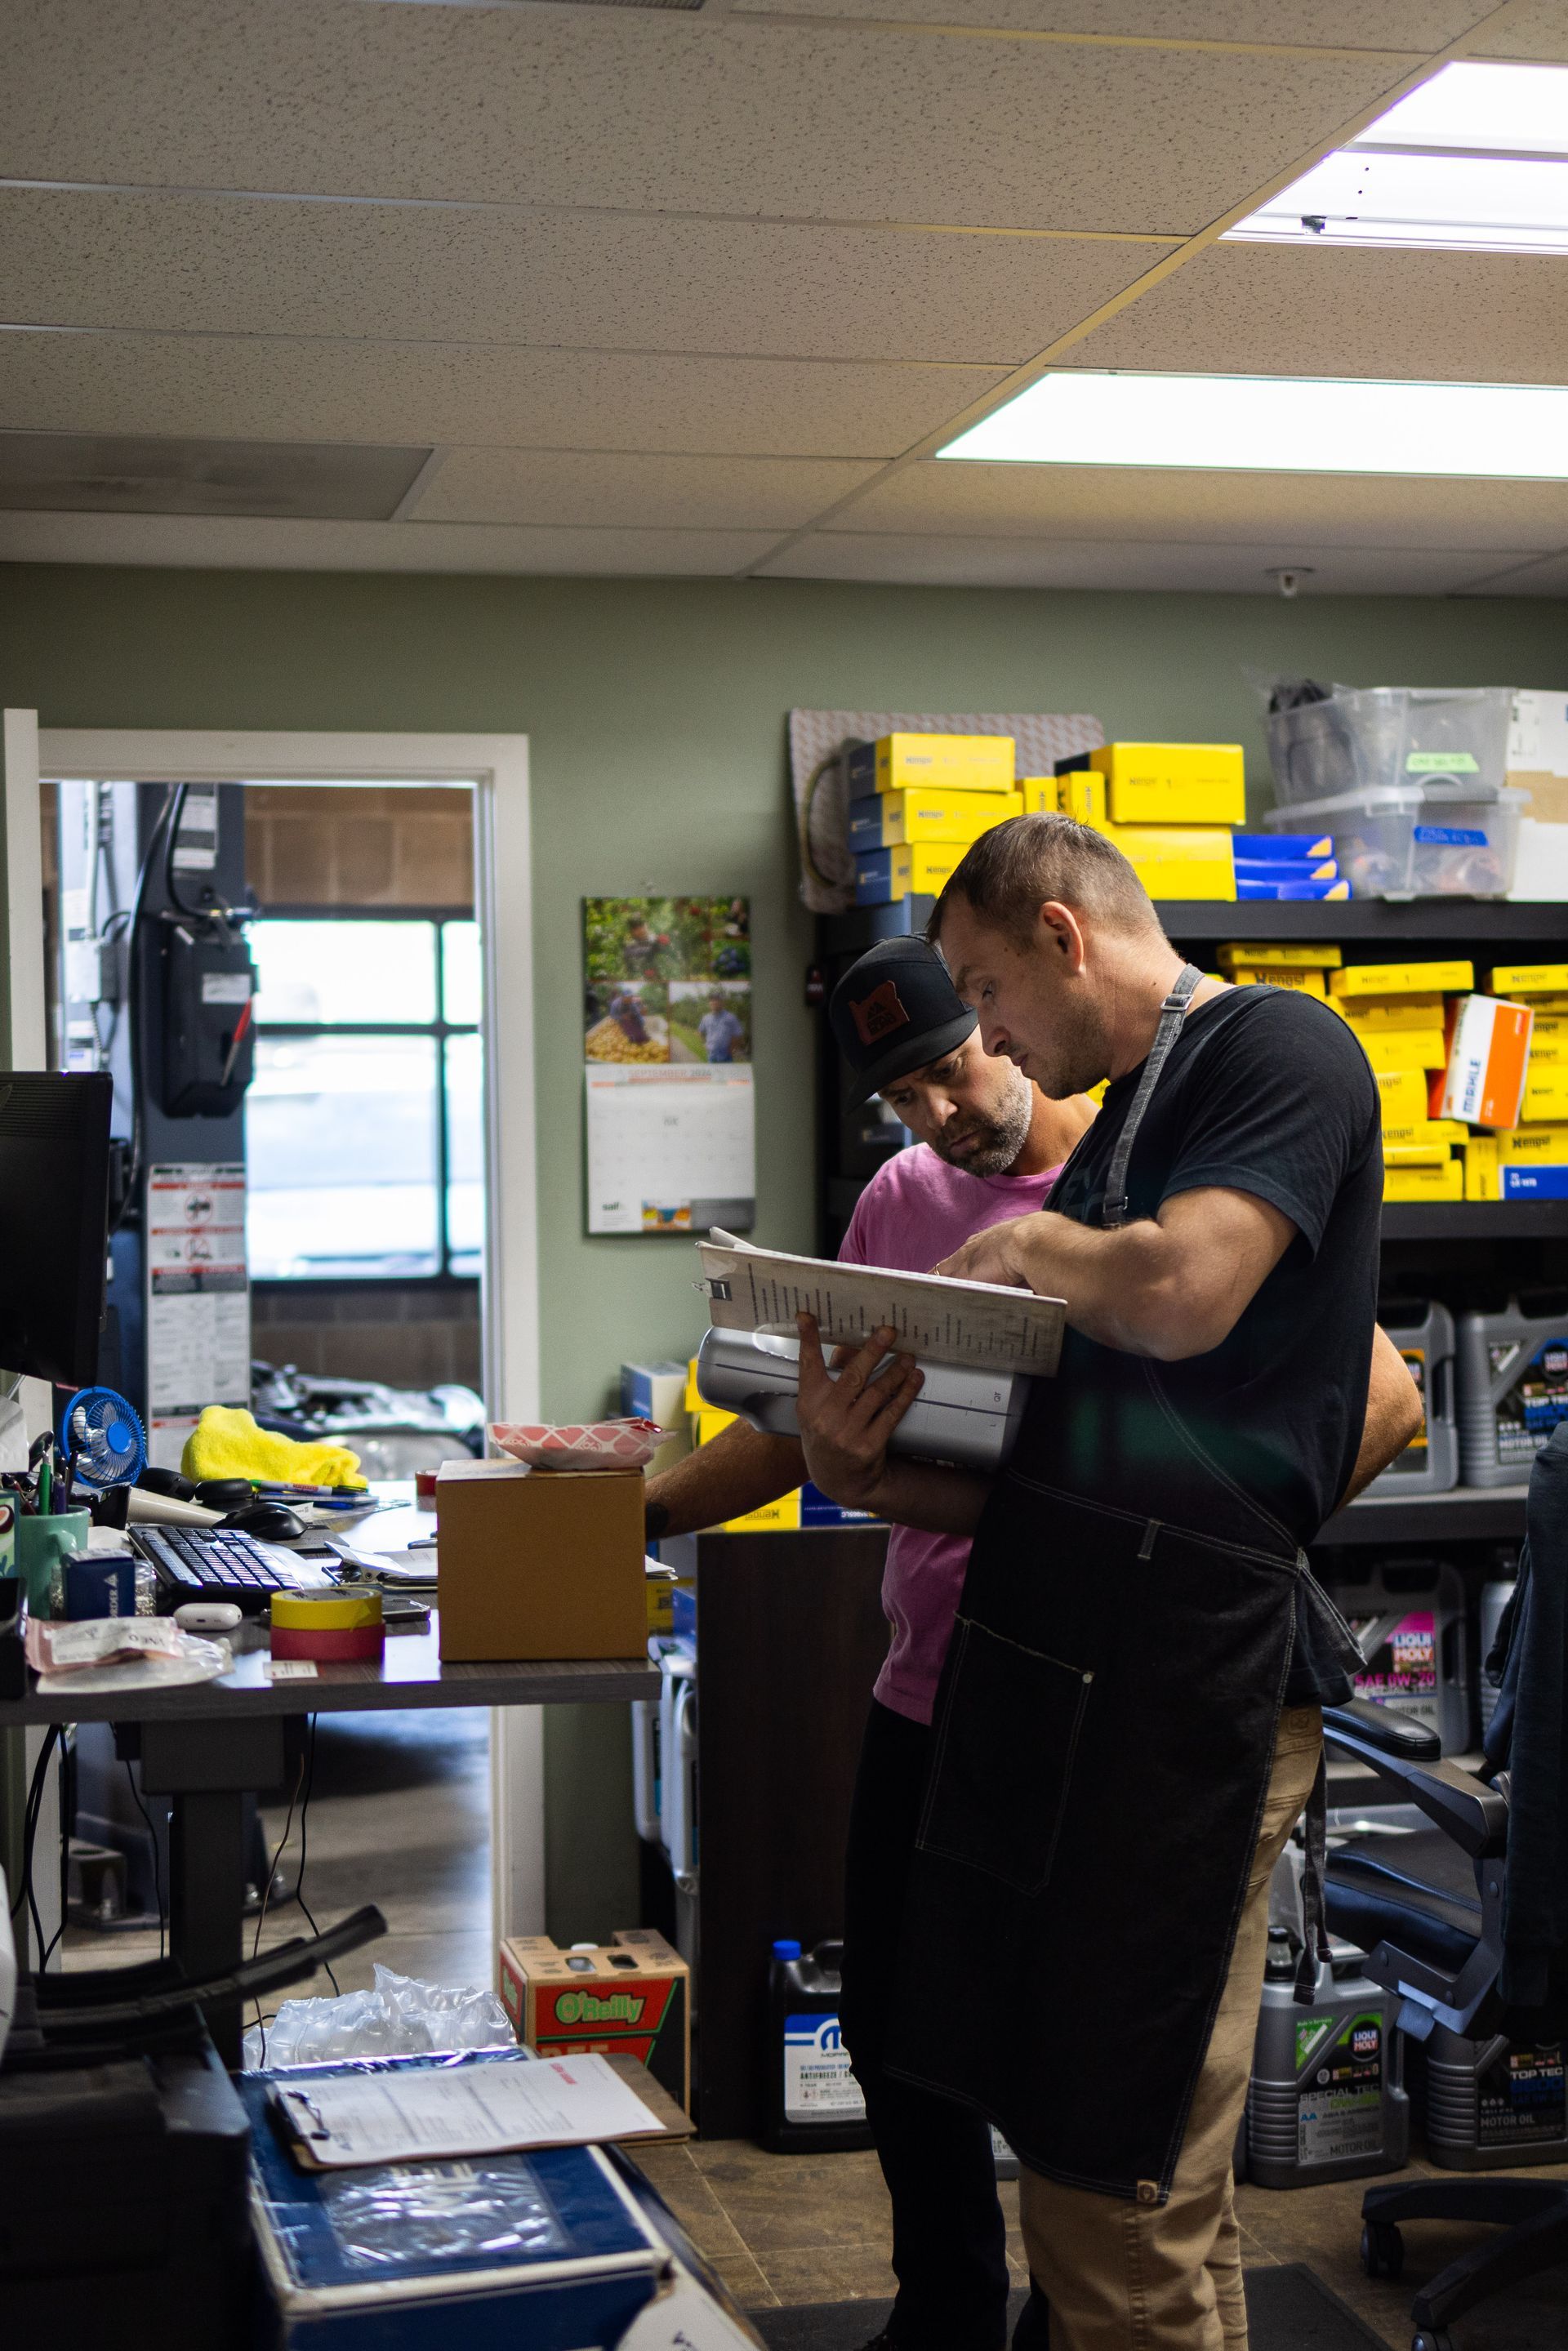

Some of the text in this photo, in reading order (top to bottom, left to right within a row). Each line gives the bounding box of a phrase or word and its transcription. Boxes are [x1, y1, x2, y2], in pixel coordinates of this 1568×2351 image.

[628, 1069, 687, 1078] SEPTEMBER
[1354, 1673, 1384, 1687] SAE
[556, 1991, 644, 2024] O'Reilly
[1354, 2030, 1377, 2042] LIQUI
[1353, 2040, 1379, 2052] MOLY
[1510, 2067, 1564, 2080] TOP TEC
[1299, 2087, 1348, 2103] SPECIAL
[1480, 2113, 1535, 2126] MOTOR OIL
